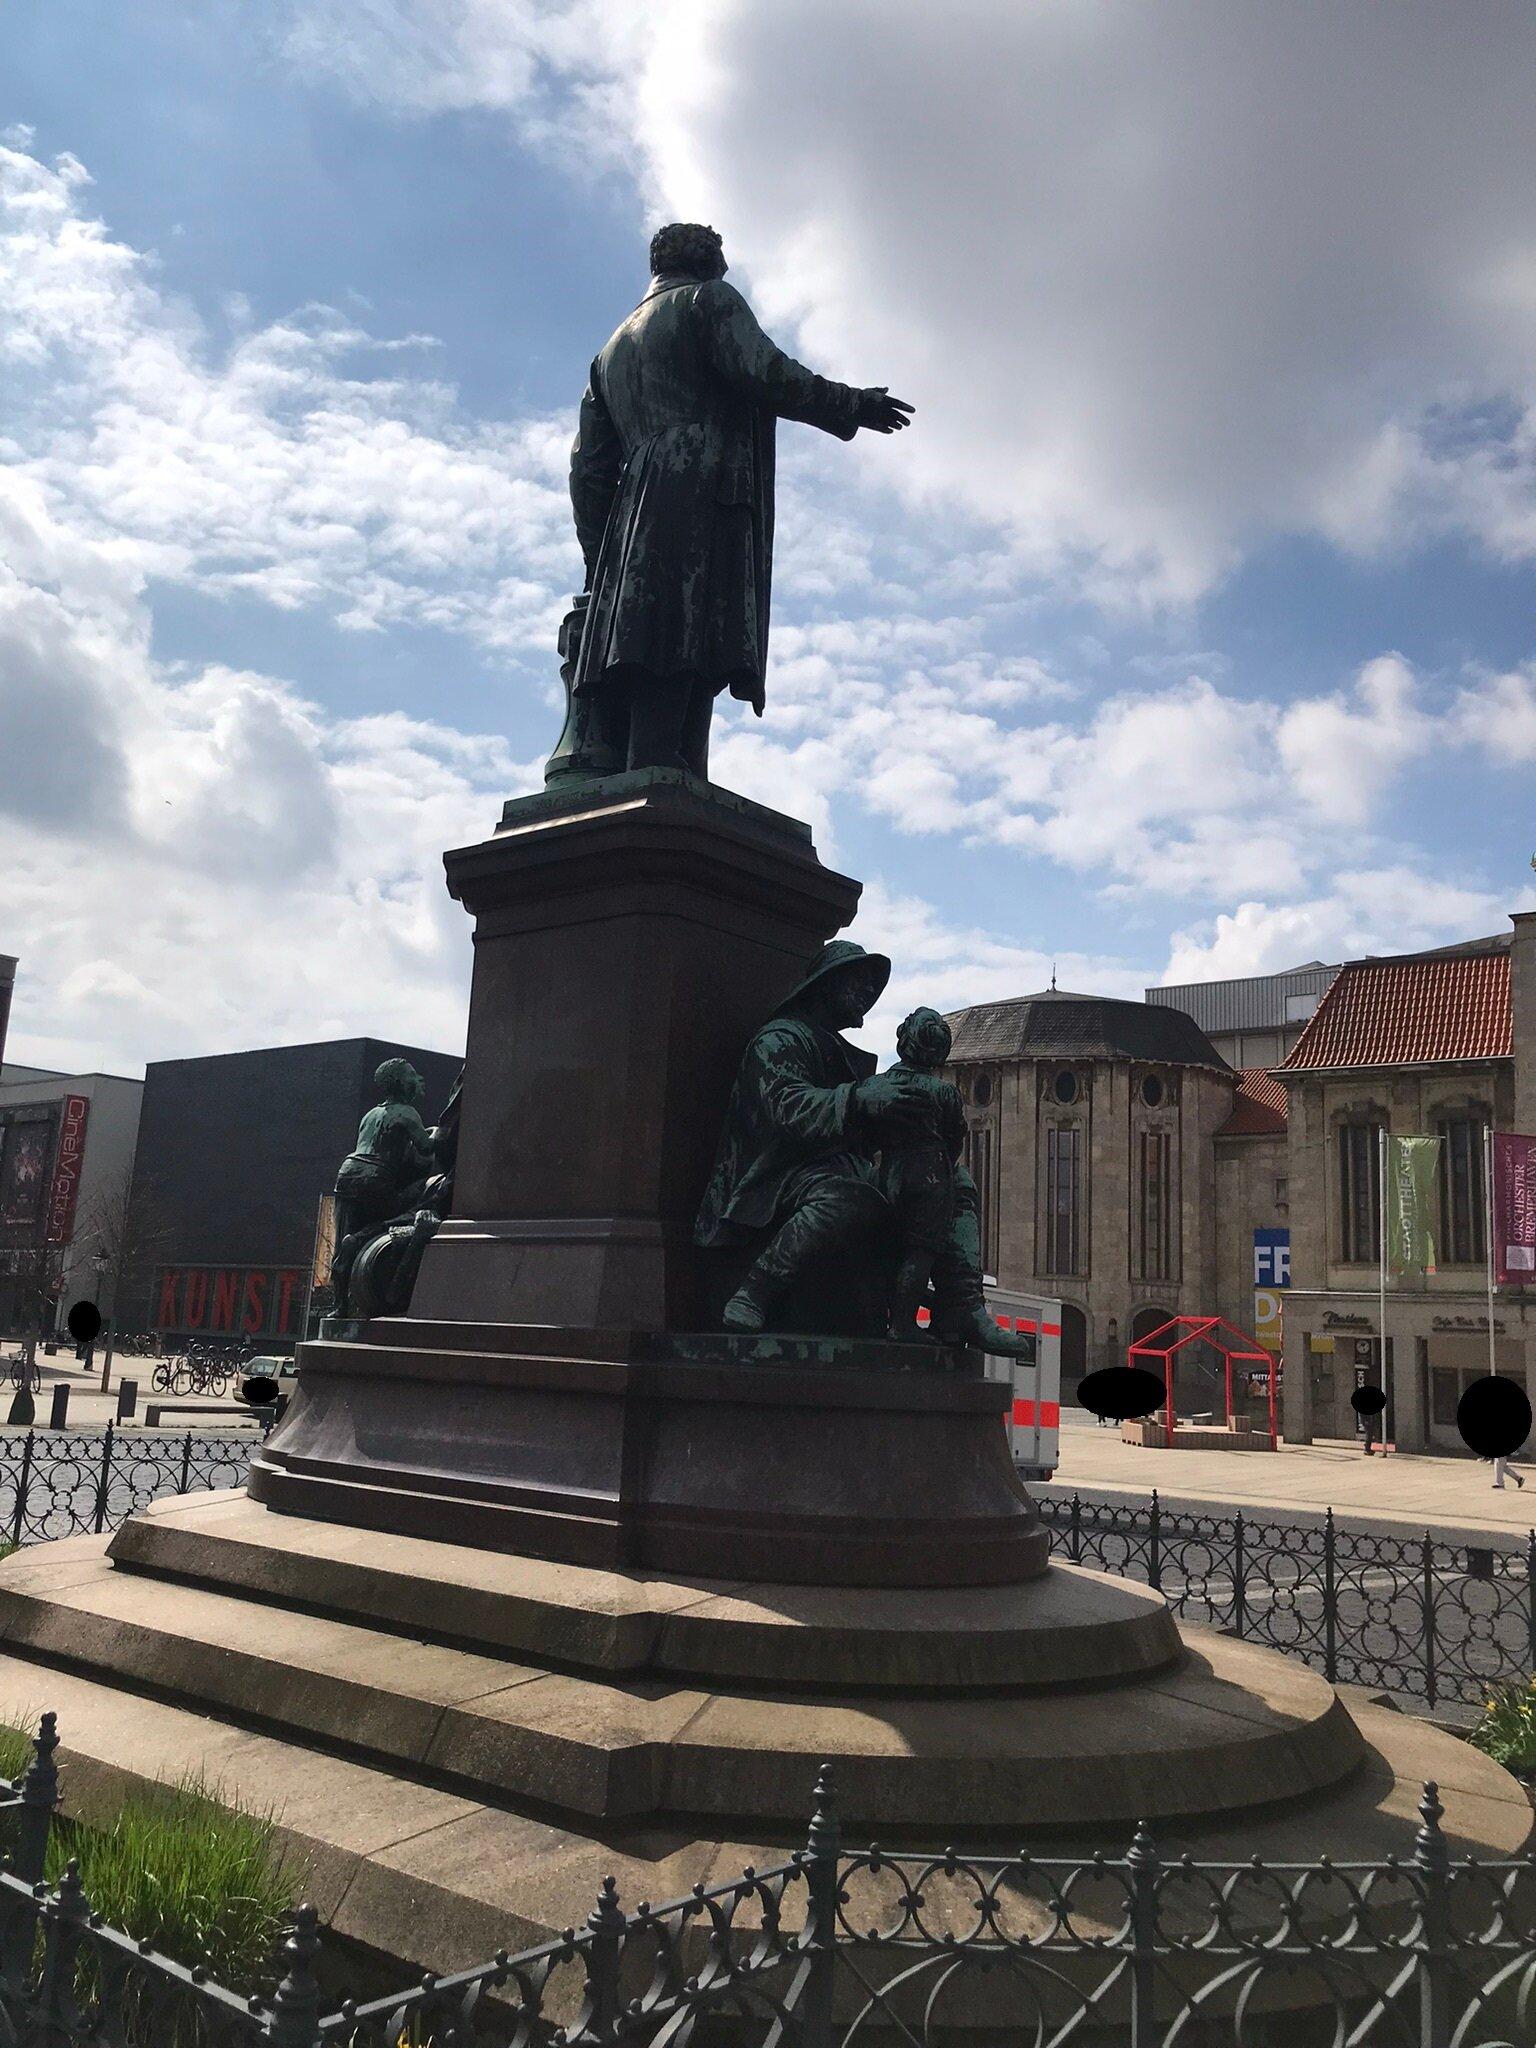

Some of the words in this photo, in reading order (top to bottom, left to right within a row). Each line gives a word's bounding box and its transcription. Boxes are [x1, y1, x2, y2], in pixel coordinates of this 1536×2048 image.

[48, 1099, 85, 1242] CineMotion
[1514, 1164, 1525, 1242] ORCHESTER
[160, 1269, 298, 1334] KUNST
